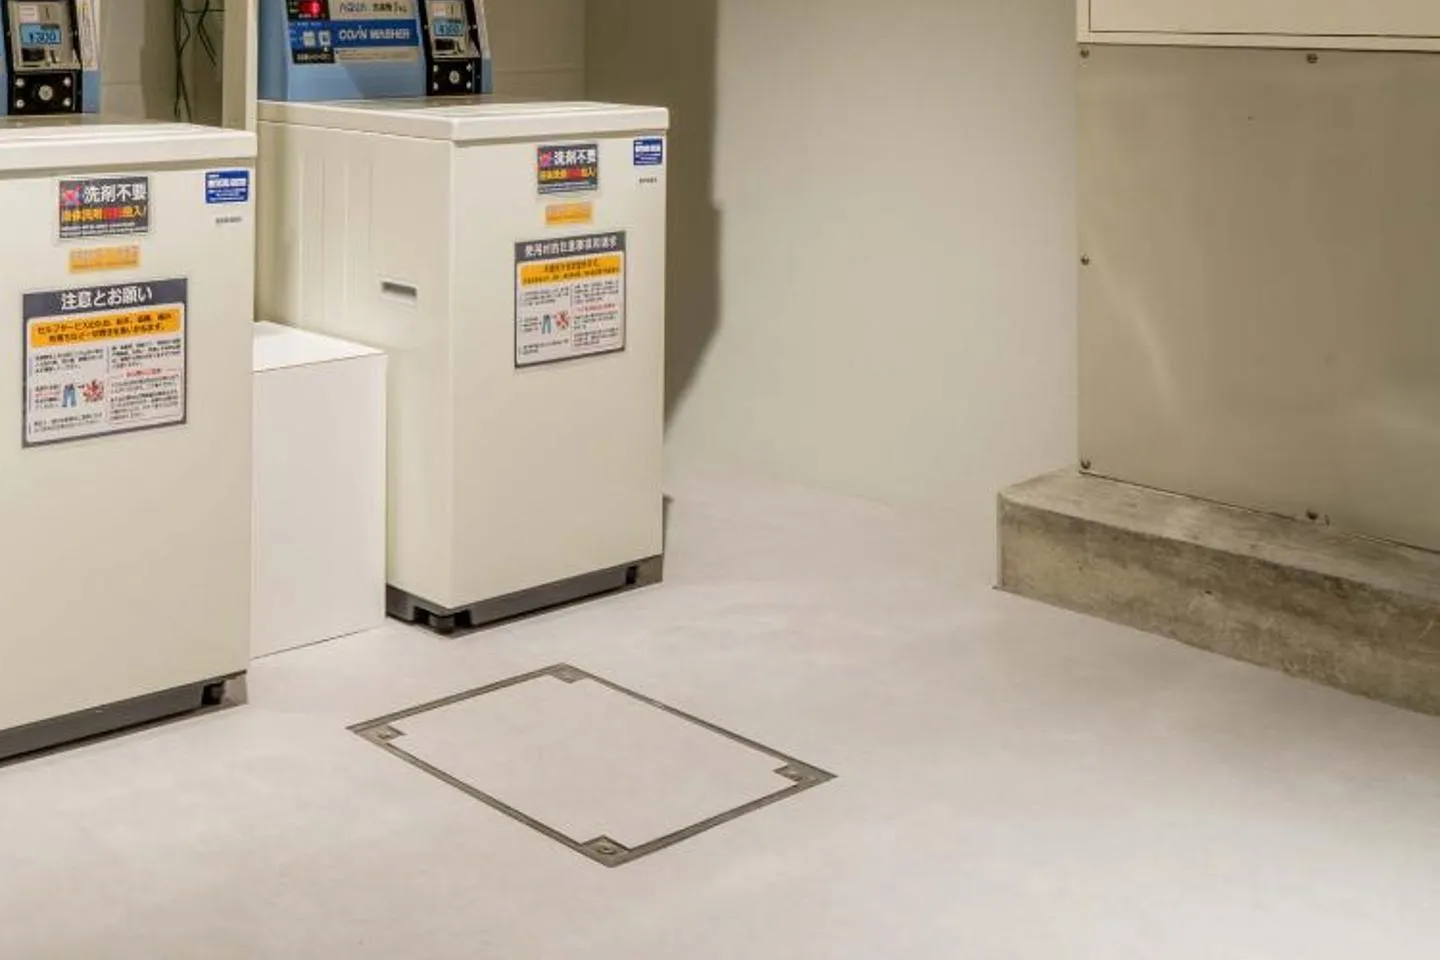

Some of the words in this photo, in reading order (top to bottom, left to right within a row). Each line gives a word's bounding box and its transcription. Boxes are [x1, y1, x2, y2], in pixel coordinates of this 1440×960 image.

[370, 28, 410, 40] WASHER
[83, 183, 147, 204] 洗剤不要
[61, 286, 153, 311] 注意とお願い
